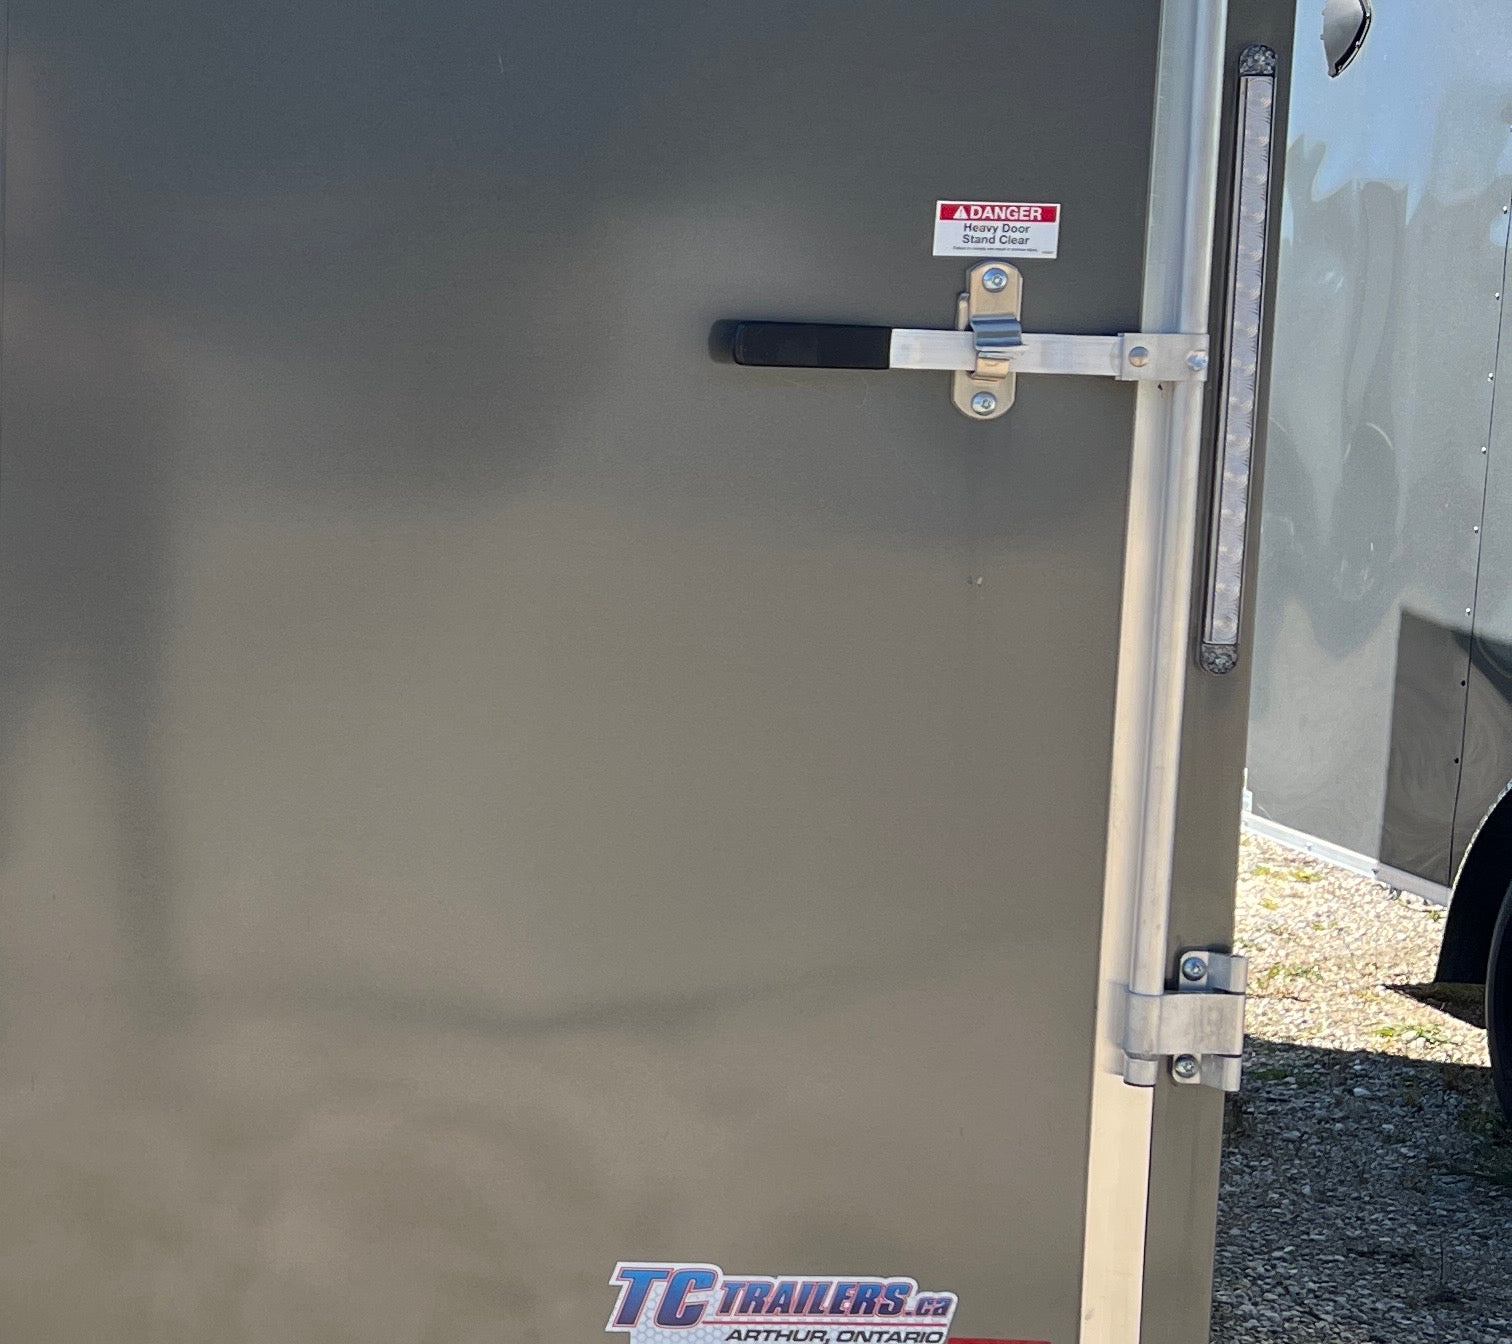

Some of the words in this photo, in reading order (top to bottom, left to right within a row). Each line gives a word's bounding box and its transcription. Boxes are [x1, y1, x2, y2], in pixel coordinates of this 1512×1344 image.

[970, 205, 1042, 221] DANGER
[963, 223, 999, 235] Heavy
[1002, 224, 1031, 233] Door
[962, 234, 995, 245] Stand
[999, 235, 1030, 245] Clear
[611, 1266, 720, 1329] TC
[716, 1280, 955, 1318] TRAILERS.ca
[724, 1328, 831, 1344] ARTHUR,
[836, 1330, 944, 1344] ONTARIO
